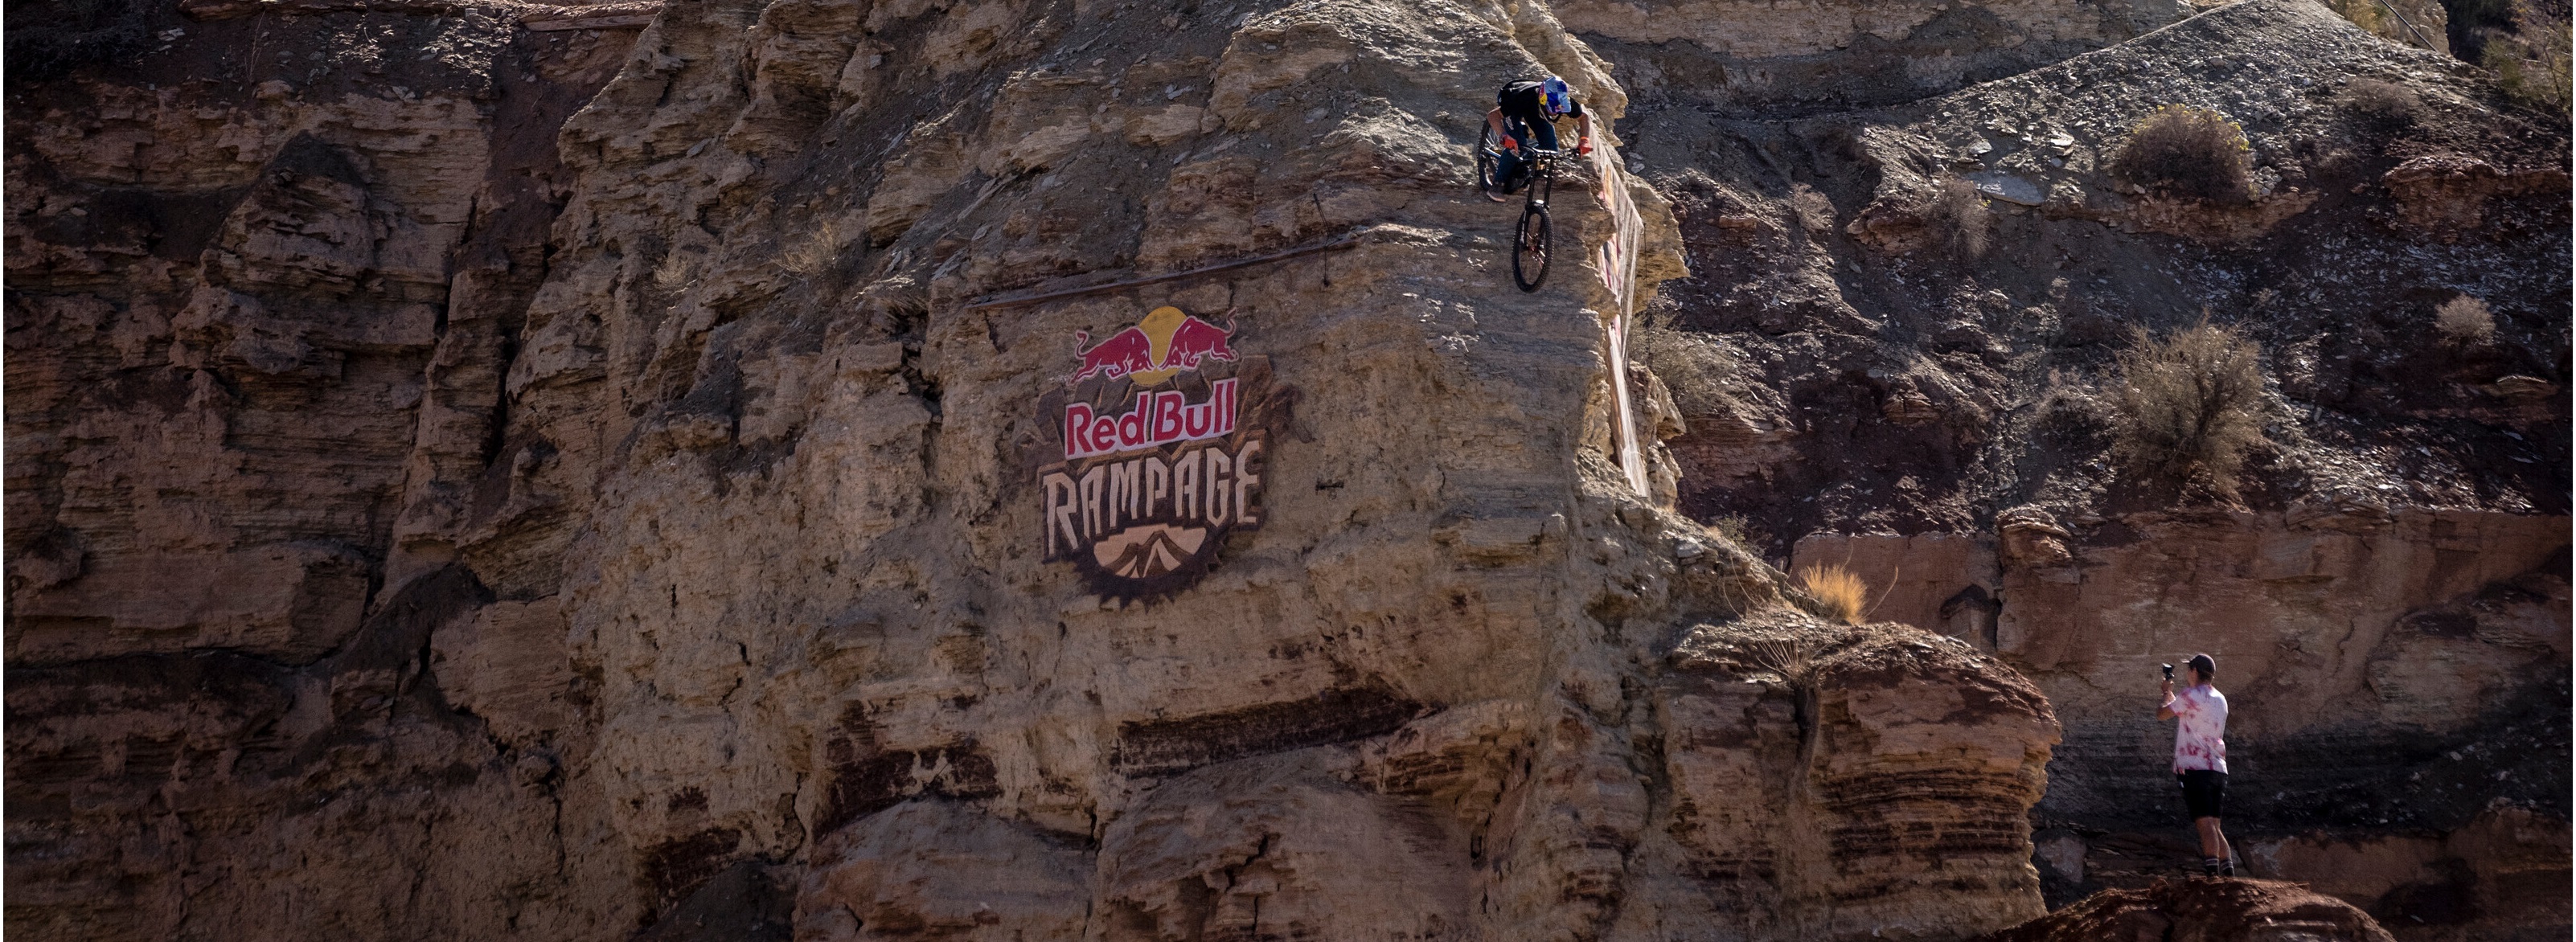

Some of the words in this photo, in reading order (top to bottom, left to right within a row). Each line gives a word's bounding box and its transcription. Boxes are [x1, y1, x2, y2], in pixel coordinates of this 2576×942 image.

[1066, 393, 1149, 456] Red
[1153, 379, 1237, 441] Bull
[1043, 440, 1259, 555] RAMPAGE
